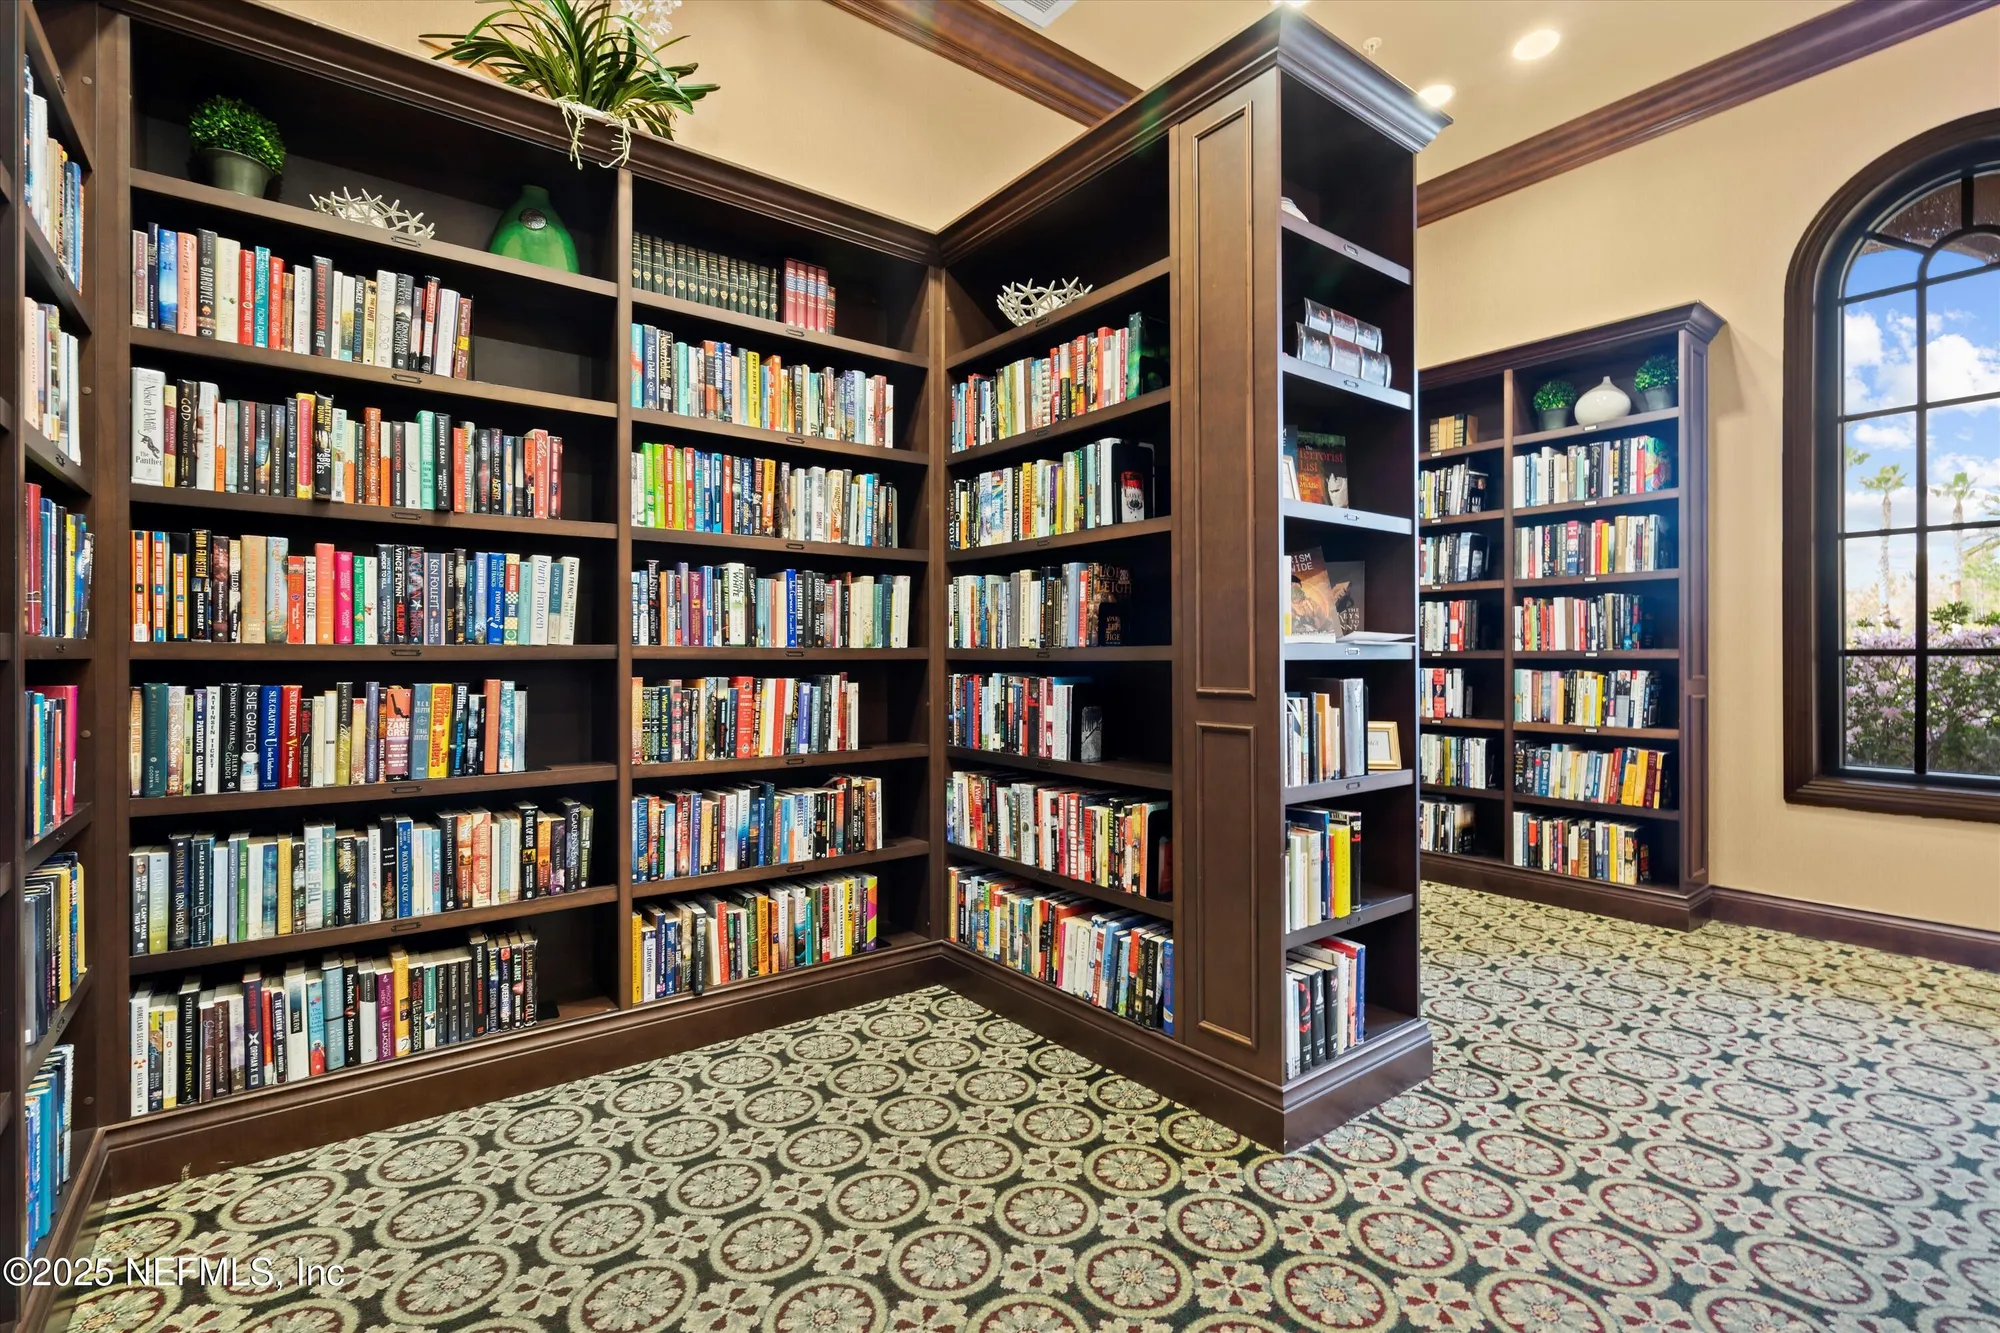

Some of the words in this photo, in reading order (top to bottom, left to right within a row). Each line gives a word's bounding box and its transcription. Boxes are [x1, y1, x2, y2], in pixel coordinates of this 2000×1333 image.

[200, 267, 213, 304] GARGOYLE
[397, 278, 405, 304] DEKKER
[317, 299, 325, 330] DEAVER
[1299, 448, 1343, 463] Terrorist
[1300, 460, 1318, 472] List
[196, 531, 206, 547] LINDA
[195, 550, 207, 577] FAIRSTEIN
[430, 559, 439, 573] KEN
[535, 560, 547, 587] Purity
[430, 576, 439, 609] FOLLETT
[536, 592, 547, 629] Franzen
[154, 870, 164, 893] JOHN
[402, 874, 408, 882] TO
[154, 896, 163, 920] HART
[176, 892, 184, 910] IRON
[526, 1004, 534, 1020] CALL
